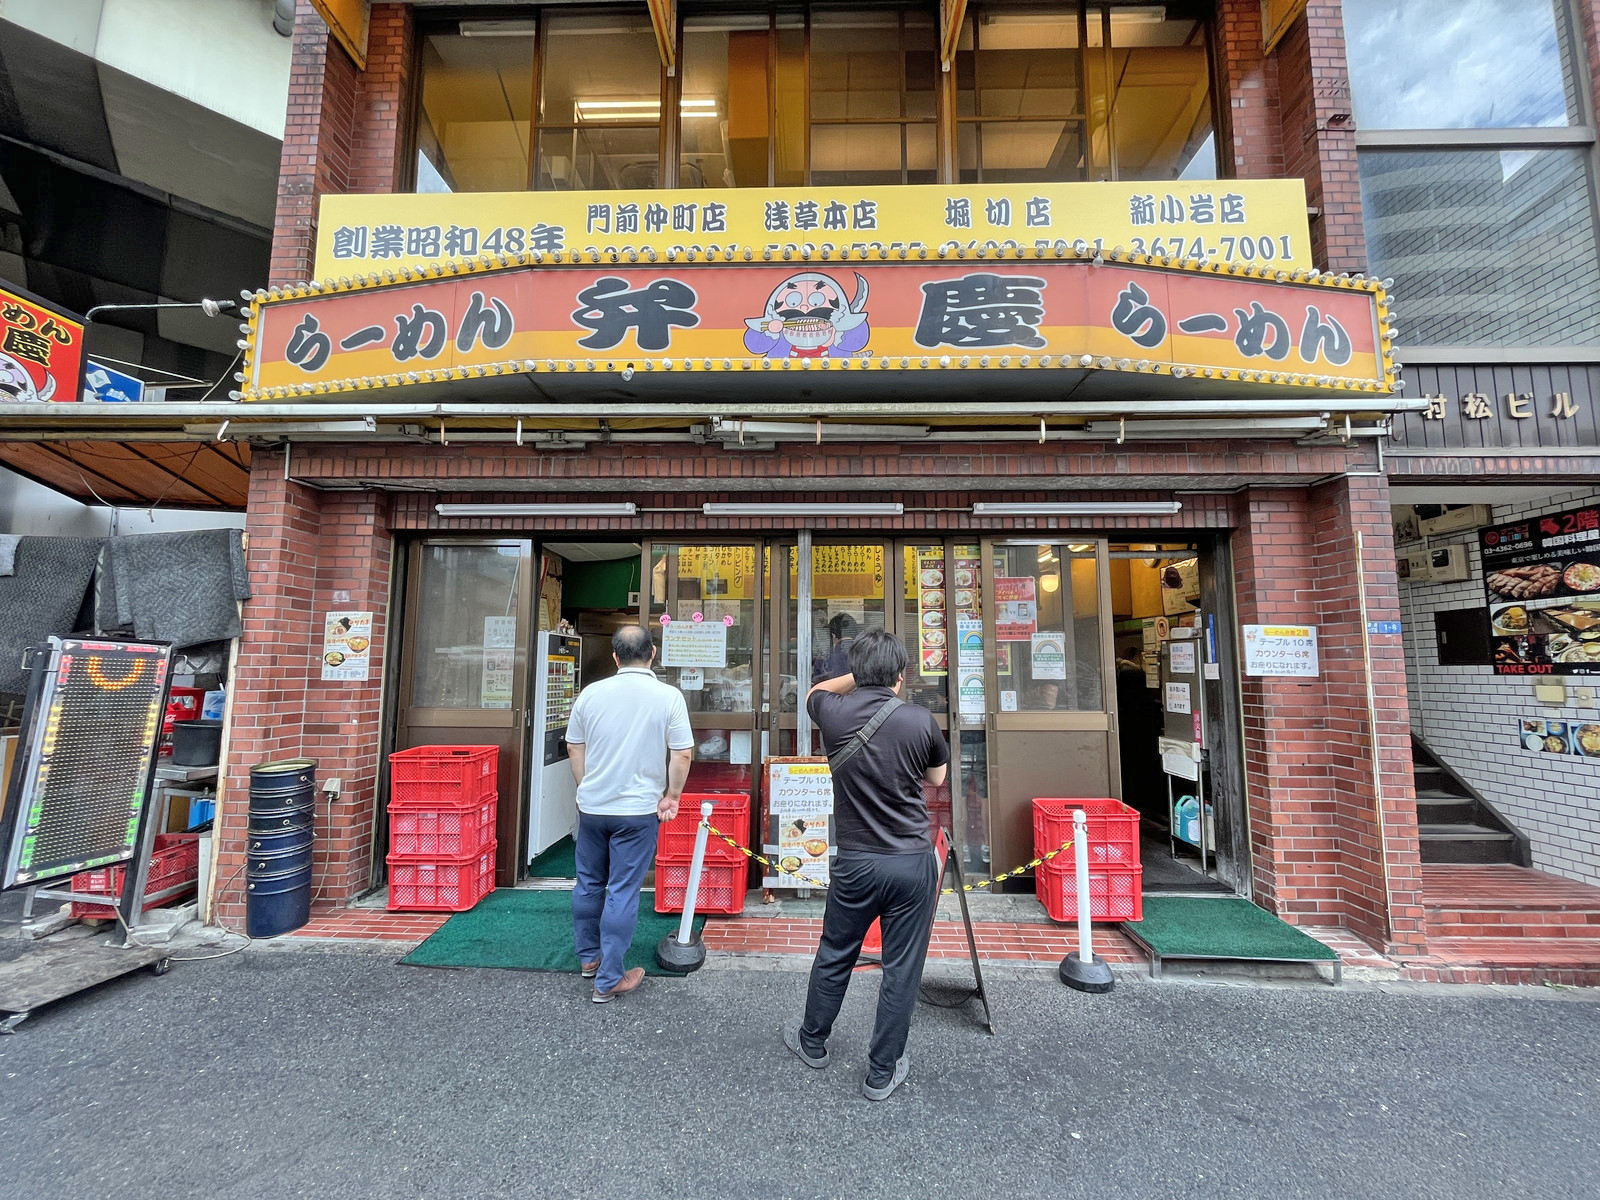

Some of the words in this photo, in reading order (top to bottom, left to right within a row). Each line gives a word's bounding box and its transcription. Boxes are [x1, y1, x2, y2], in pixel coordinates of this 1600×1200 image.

[587, 202, 727, 233] 門前仲町店
[764, 200, 877, 231] 浅草本店
[944, 197, 1051, 228] 堀切店
[1130, 193, 1245, 225] 新小岩店
[333, 223, 565, 259] 創業昭和48年
[1131, 235, 1292, 262] 3674-7001
[286, 291, 515, 373] らーめん
[1110, 280, 1353, 367] らーめん
[1422, 391, 1580, 420] 村松ビル
[1562, 510, 1600, 533] 2階
[1260, 638, 1290, 647] テーブル
[1255, 650, 1310, 659] カウンター6席
[1497, 664, 1524, 674] TAKE
[1528, 664, 1553, 674] OUT
[778, 788, 831, 796] カウンター6席
[784, 776, 814, 785] テーブル
